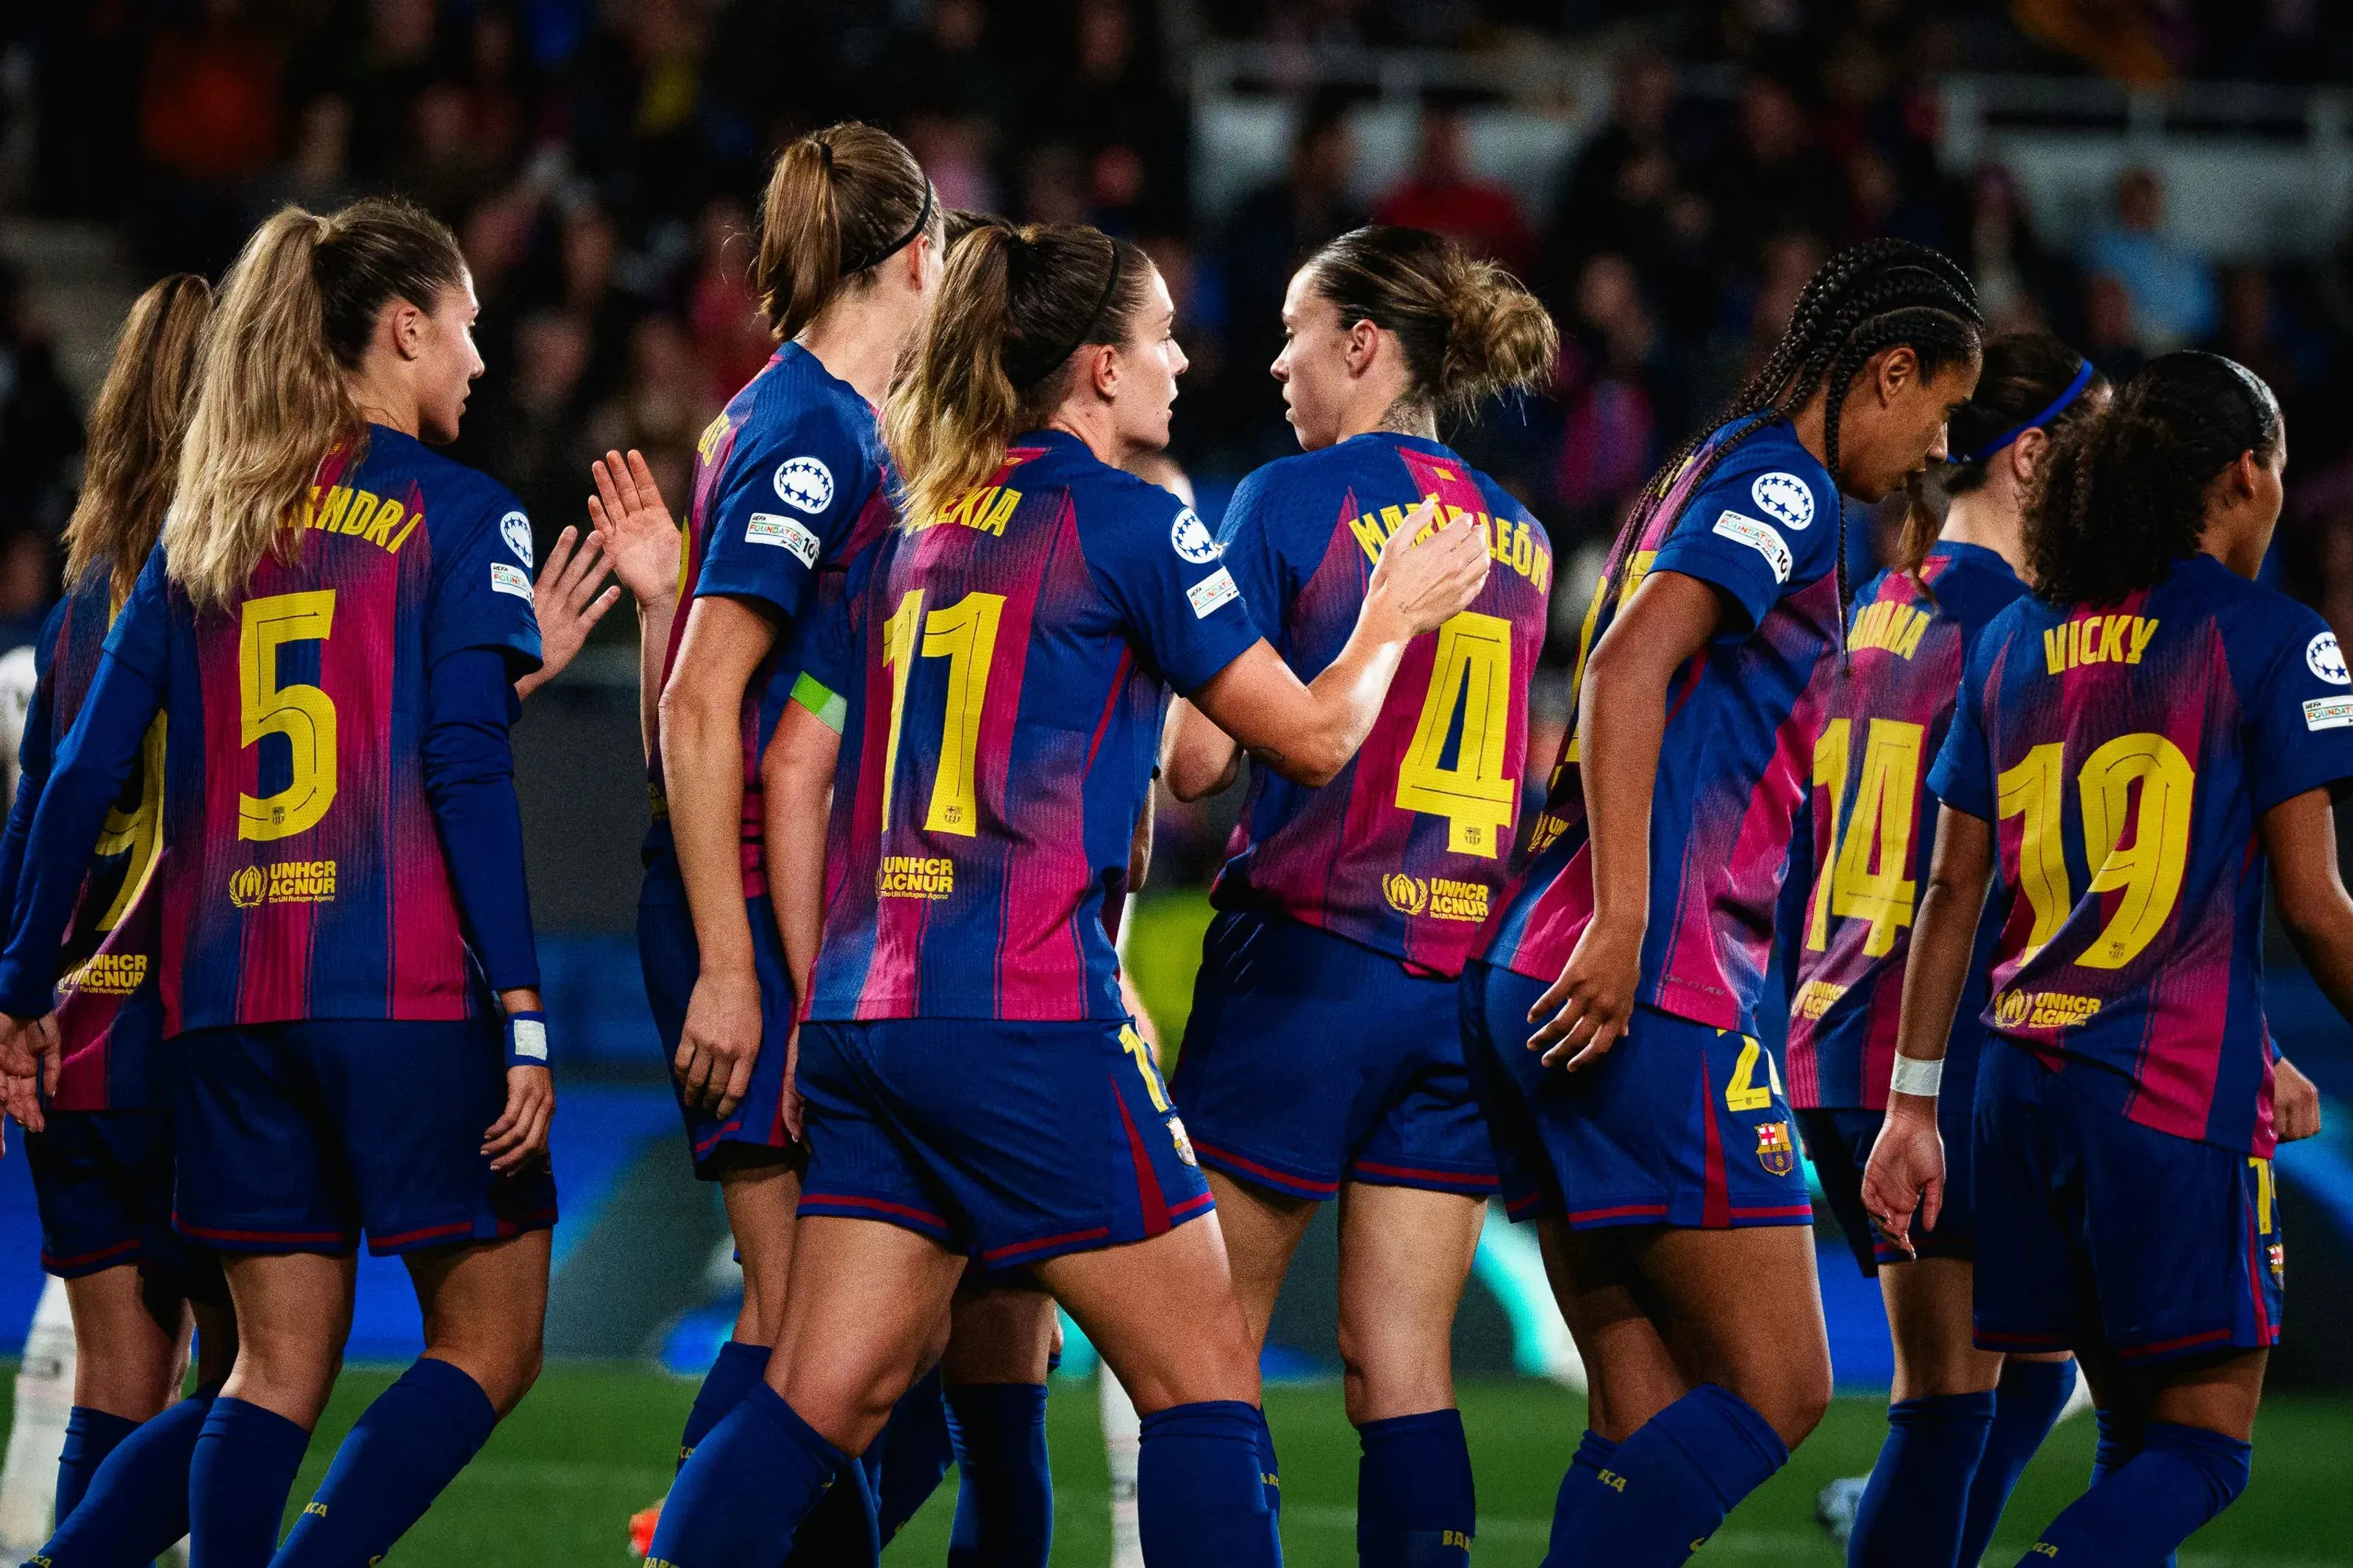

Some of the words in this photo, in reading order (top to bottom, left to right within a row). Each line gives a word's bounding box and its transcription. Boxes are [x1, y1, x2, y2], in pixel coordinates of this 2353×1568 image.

[277, 485, 423, 555] ANDRI
[749, 524, 803, 545] FOUNDATION
[1720, 518, 1778, 553] FOUNDATION
[1477, 512, 1549, 595] LEÓN
[2043, 616, 2160, 676] VICKY
[238, 590, 337, 841] 5
[882, 588, 1008, 839] 11
[1396, 610, 1515, 859] 4
[1805, 717, 1925, 958] 14
[1998, 732, 2196, 970] 19
[271, 860, 337, 880] UNHCR
[882, 856, 954, 876] UNHCR
[268, 877, 336, 897] ACNUR
[880, 873, 954, 892] ACNUR
[1430, 877, 1489, 902] UNHCR
[314, 895, 336, 903] Agency
[1429, 895, 1489, 917] ACNUR
[2035, 992, 2102, 1014] UNHCR
